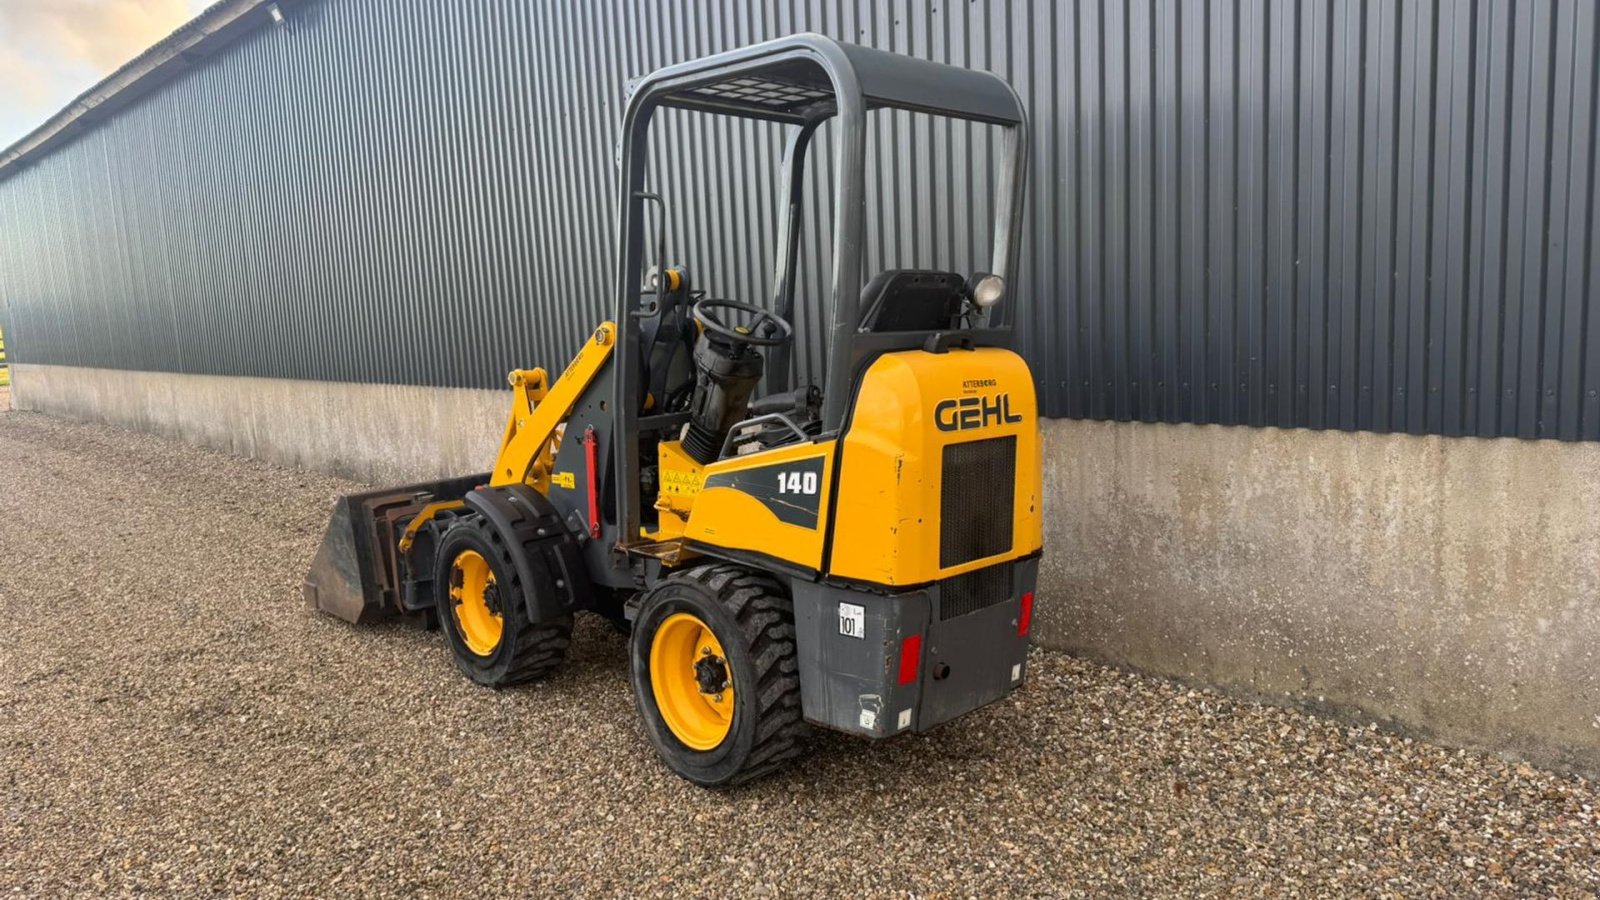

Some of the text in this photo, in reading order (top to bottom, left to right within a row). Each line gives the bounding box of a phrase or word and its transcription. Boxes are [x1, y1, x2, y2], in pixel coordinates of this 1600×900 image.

[934, 393, 1022, 432] GEHL
[777, 471, 817, 495] 140
[840, 616, 855, 635] 101
